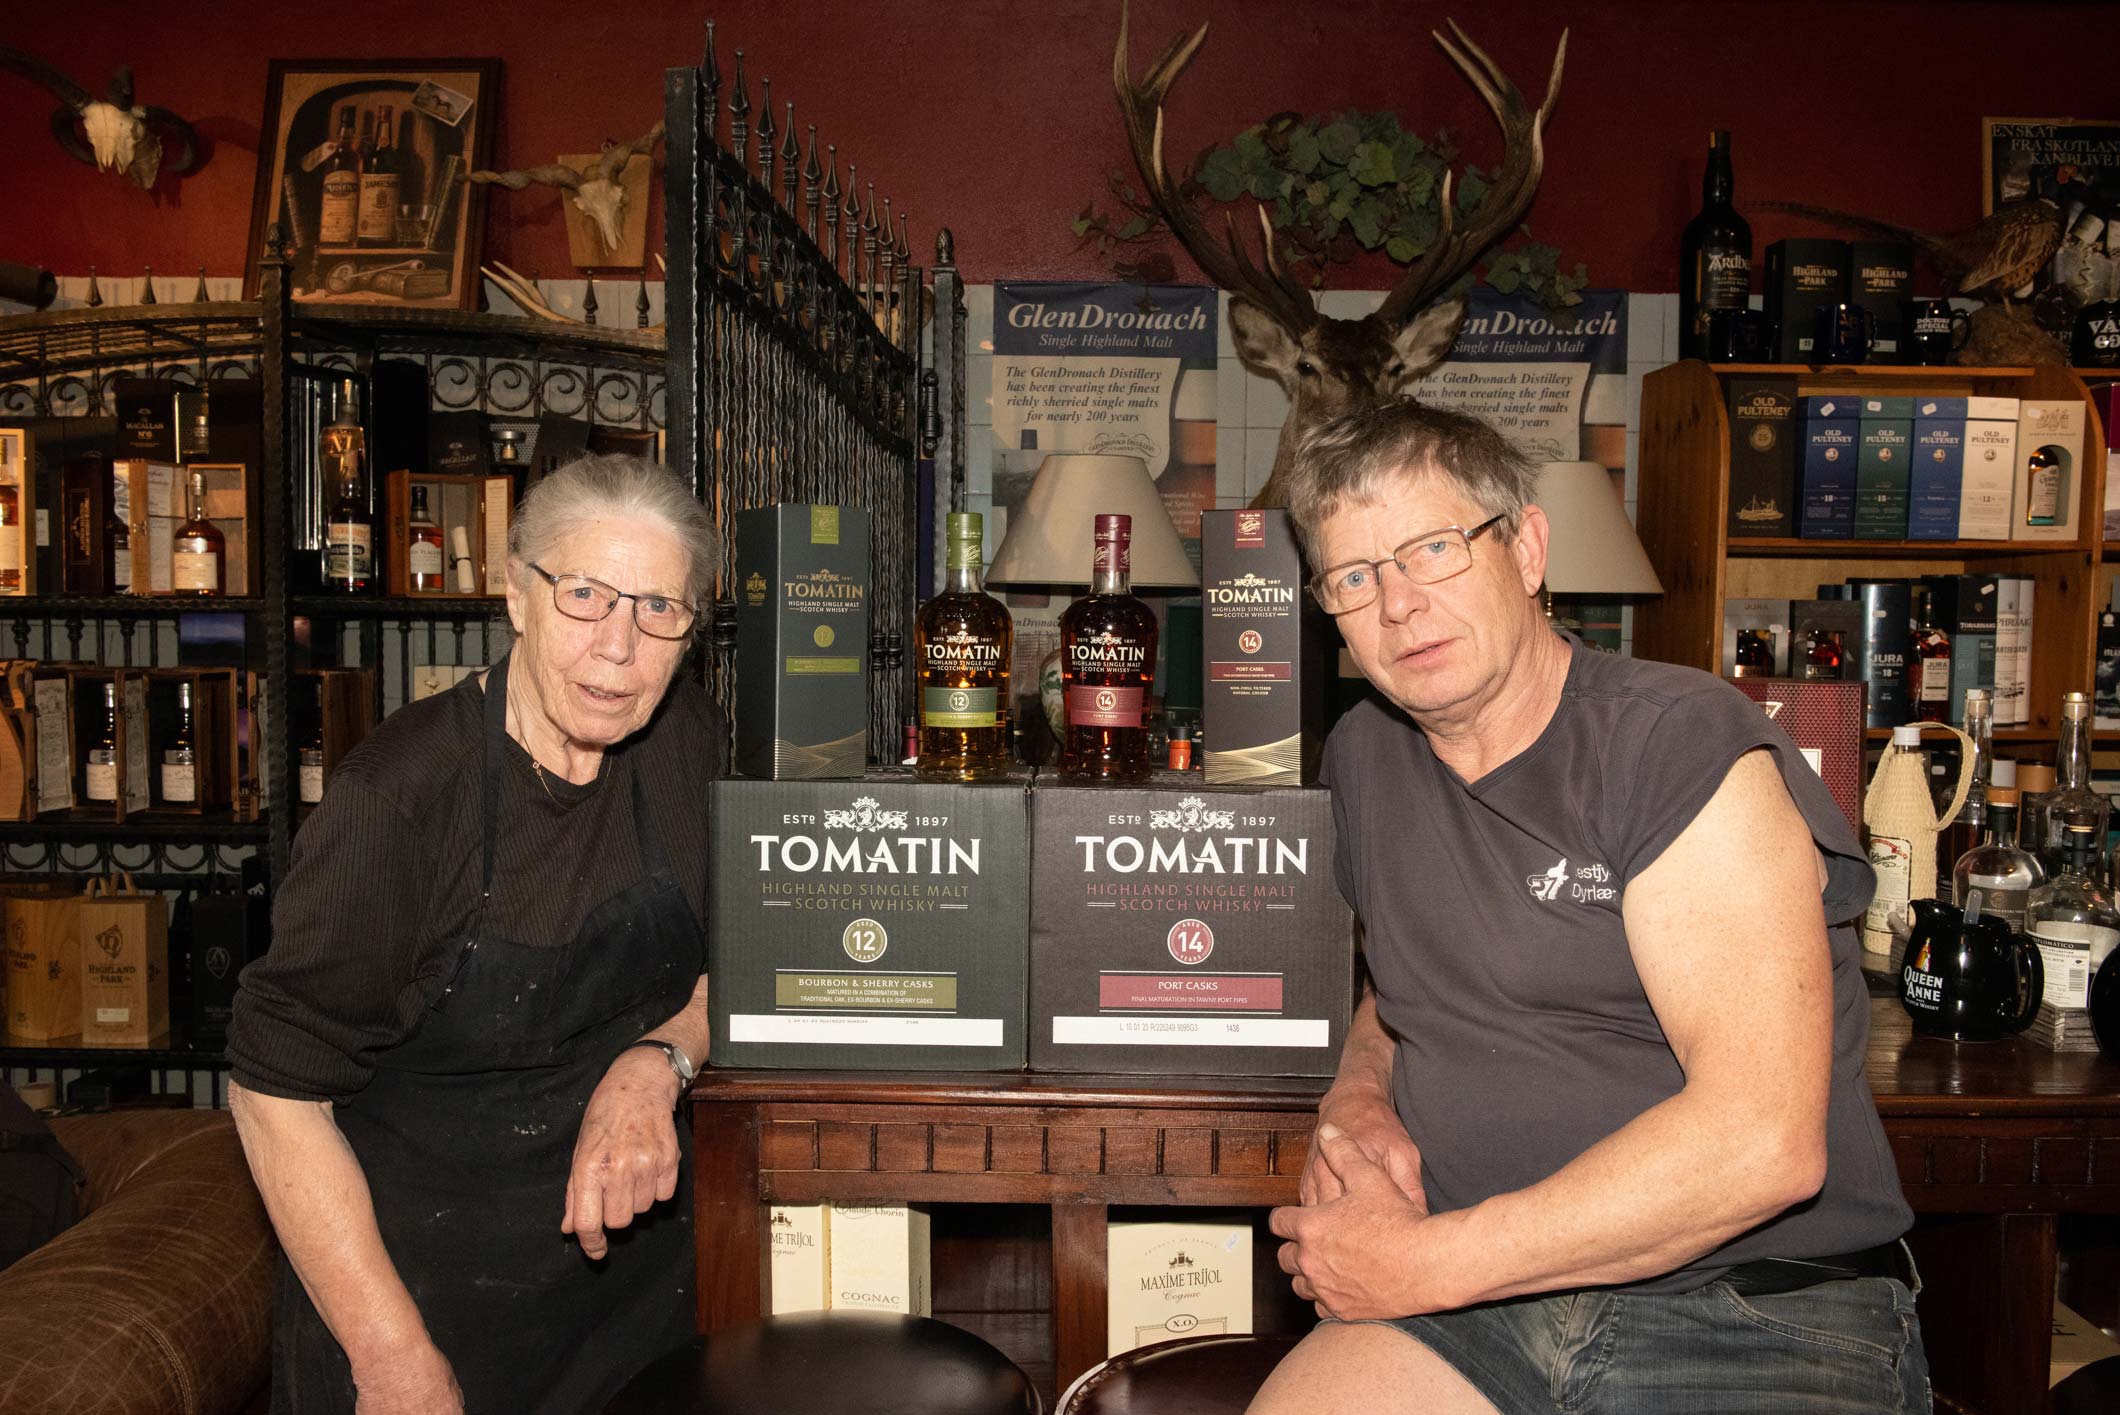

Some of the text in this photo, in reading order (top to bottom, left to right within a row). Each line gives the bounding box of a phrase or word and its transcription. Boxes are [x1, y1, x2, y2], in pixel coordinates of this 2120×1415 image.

[2016, 126, 2057, 138] SKAT
[2010, 139, 2120, 152] FRA SKOTLAN
[1792, 266, 1838, 277] HIGHLAND
[1861, 267, 1907, 279] HIGHLAND
[1804, 277, 1827, 286] PARK
[1873, 278, 1896, 287] PARK
[1008, 303, 1208, 331] GlenDronach
[1458, 310, 1617, 336] enDroch
[2088, 320, 2120, 336] VA
[1039, 334, 1174, 348] Single Highland Malt
[1452, 340, 1585, 355] Single Highland Malt
[1006, 366, 1162, 381] The GlenDronach Distillery
[1442, 372, 1517, 384] GlenDronach
[1520, 373, 1573, 386] Distillery
[1006, 381, 1160, 395] has been creating the finest
[1417, 387, 1571, 400] has been creating the finest
[1007, 395, 1159, 410] richly sherried single malts
[1502, 402, 1569, 415] single malts
[1752, 397, 1776, 407] OLD
[1024, 409, 1139, 424] for nearly 200 years
[1737, 406, 1793, 416] PULTENEY
[1520, 418, 1550, 429] years
[1865, 436, 1906, 444] PULTENEY
[1877, 429, 1895, 437] OLD
[784, 582, 863, 599] TOMATIN
[1207, 587, 1294, 603] TOMATIN
[1243, 636, 1257, 648] 14
[925, 644, 1001, 660] TOMATIN
[1069, 645, 1145, 661] TOMATIN
[1871, 654, 1904, 663] JURA
[1882, 668, 1893, 678] 18
[953, 696, 965, 707] 12
[1100, 695, 1112, 706] 14
[914, 816, 949, 827] 1897
[1242, 816, 1276, 827] 1897
[750, 834, 981, 875] TOMATIN
[1075, 835, 1309, 875] TOMATIN
[761, 882, 970, 898] HIGHLAND SINGLE MALT
[1086, 882, 1296, 897] HIGHLAND SINGLE MALT
[1572, 883, 1616, 903] Dyrlæ
[794, 897, 936, 912] SCOTCH WHISKY
[1119, 898, 1263, 912] SCOTCH WHISKY
[852, 930, 876, 951] 12
[1177, 931, 1204, 953] 14
[88, 964, 136, 974] HIGHLAND
[100, 975, 123, 983] PARK
[798, 978, 934, 989] BOURBON & SHERRY CASKS
[1904, 965, 1944, 989] QUEEN
[1158, 981, 1218, 991] PORT CASKS
[1906, 981, 1941, 1002] ANNE
[847, 996, 881, 1004] EX-BOURBON
[916, 997, 934, 1005] CASKS
[1919, 1002, 1939, 1011] WHISKY
[786, 1232, 815, 1249] TRIJOL
[1140, 1268, 1222, 1291] MAXIME TRIJOL
[841, 1291, 901, 1305] COGNAC
[1162, 1290, 1201, 1304] Cognac
[1173, 1319, 1194, 1328] X.O.
